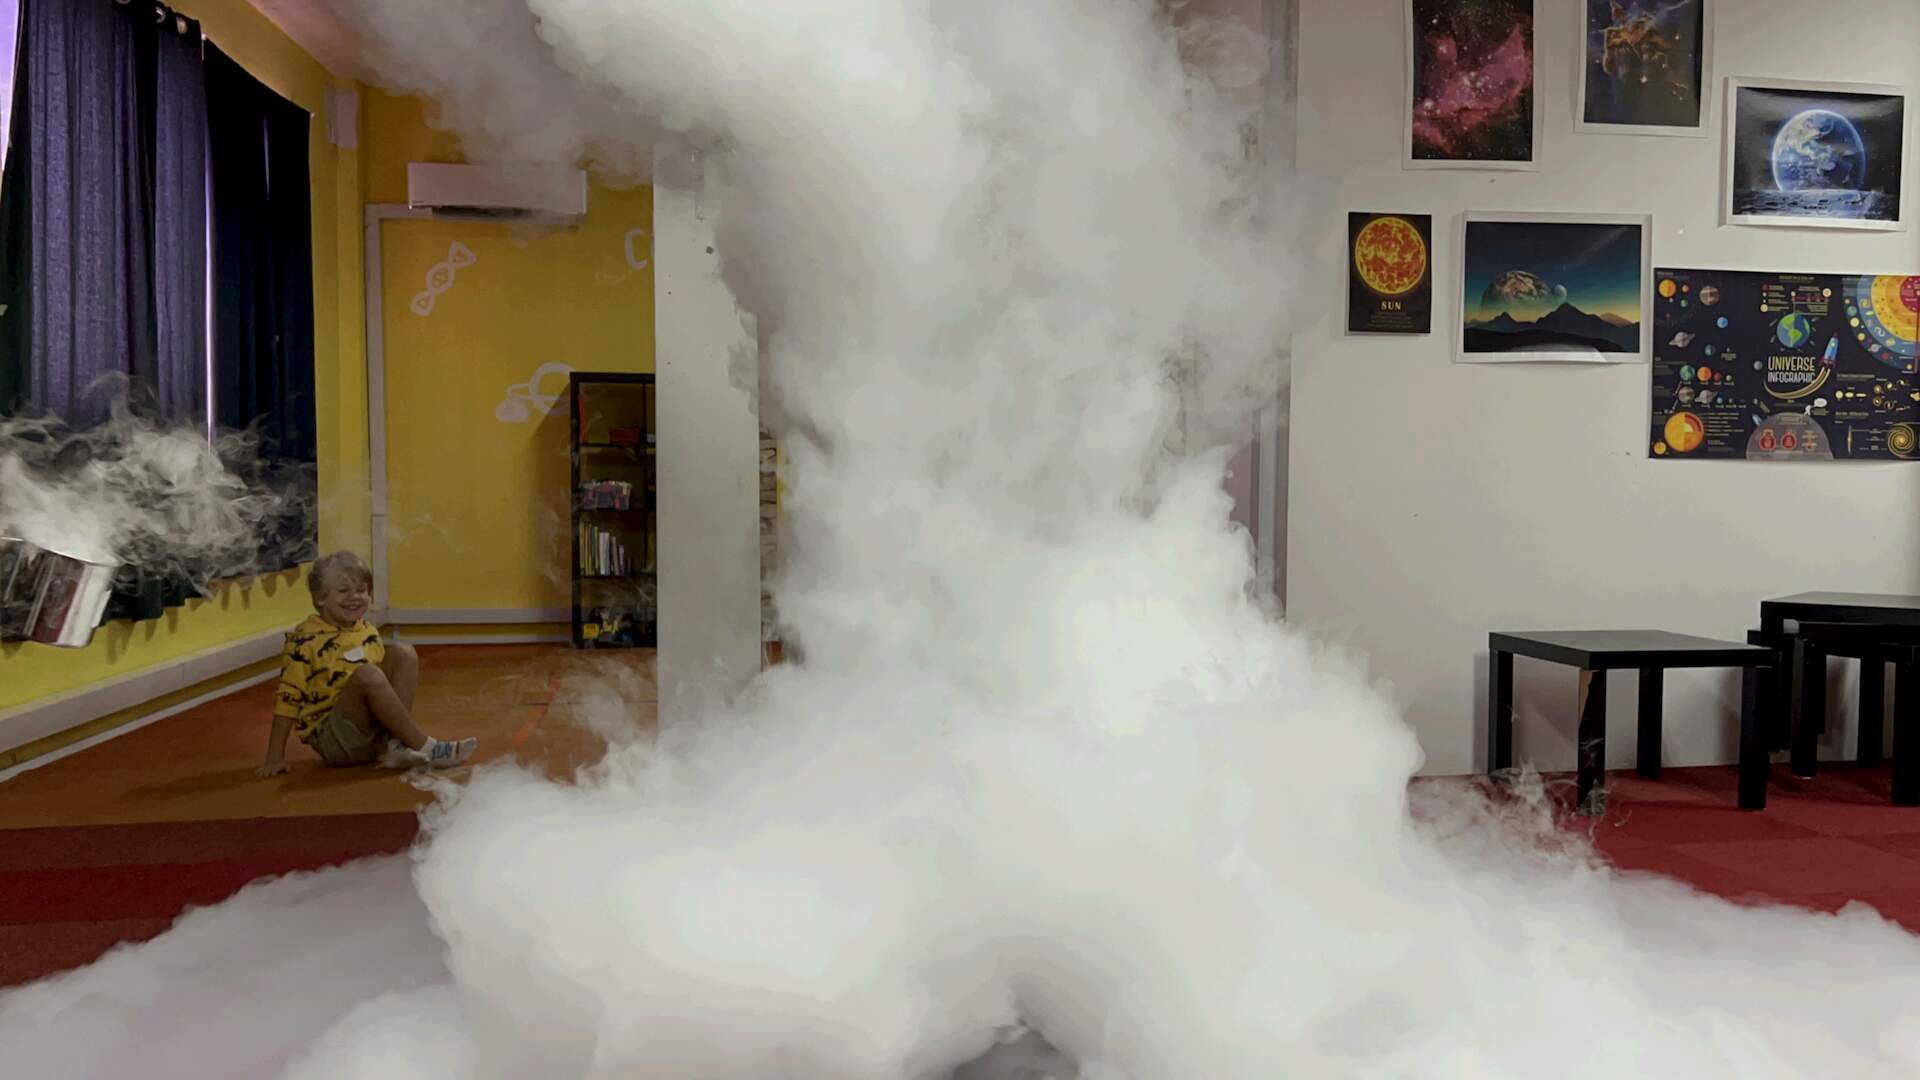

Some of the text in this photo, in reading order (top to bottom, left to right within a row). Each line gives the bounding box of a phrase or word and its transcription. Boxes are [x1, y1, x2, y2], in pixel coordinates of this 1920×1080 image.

[624, 228, 655, 270] C
[1381, 301, 1402, 310] SUN
[1767, 356, 1816, 372] UNIVERSE
[1767, 371, 1816, 383] INFOGRAPHIC
